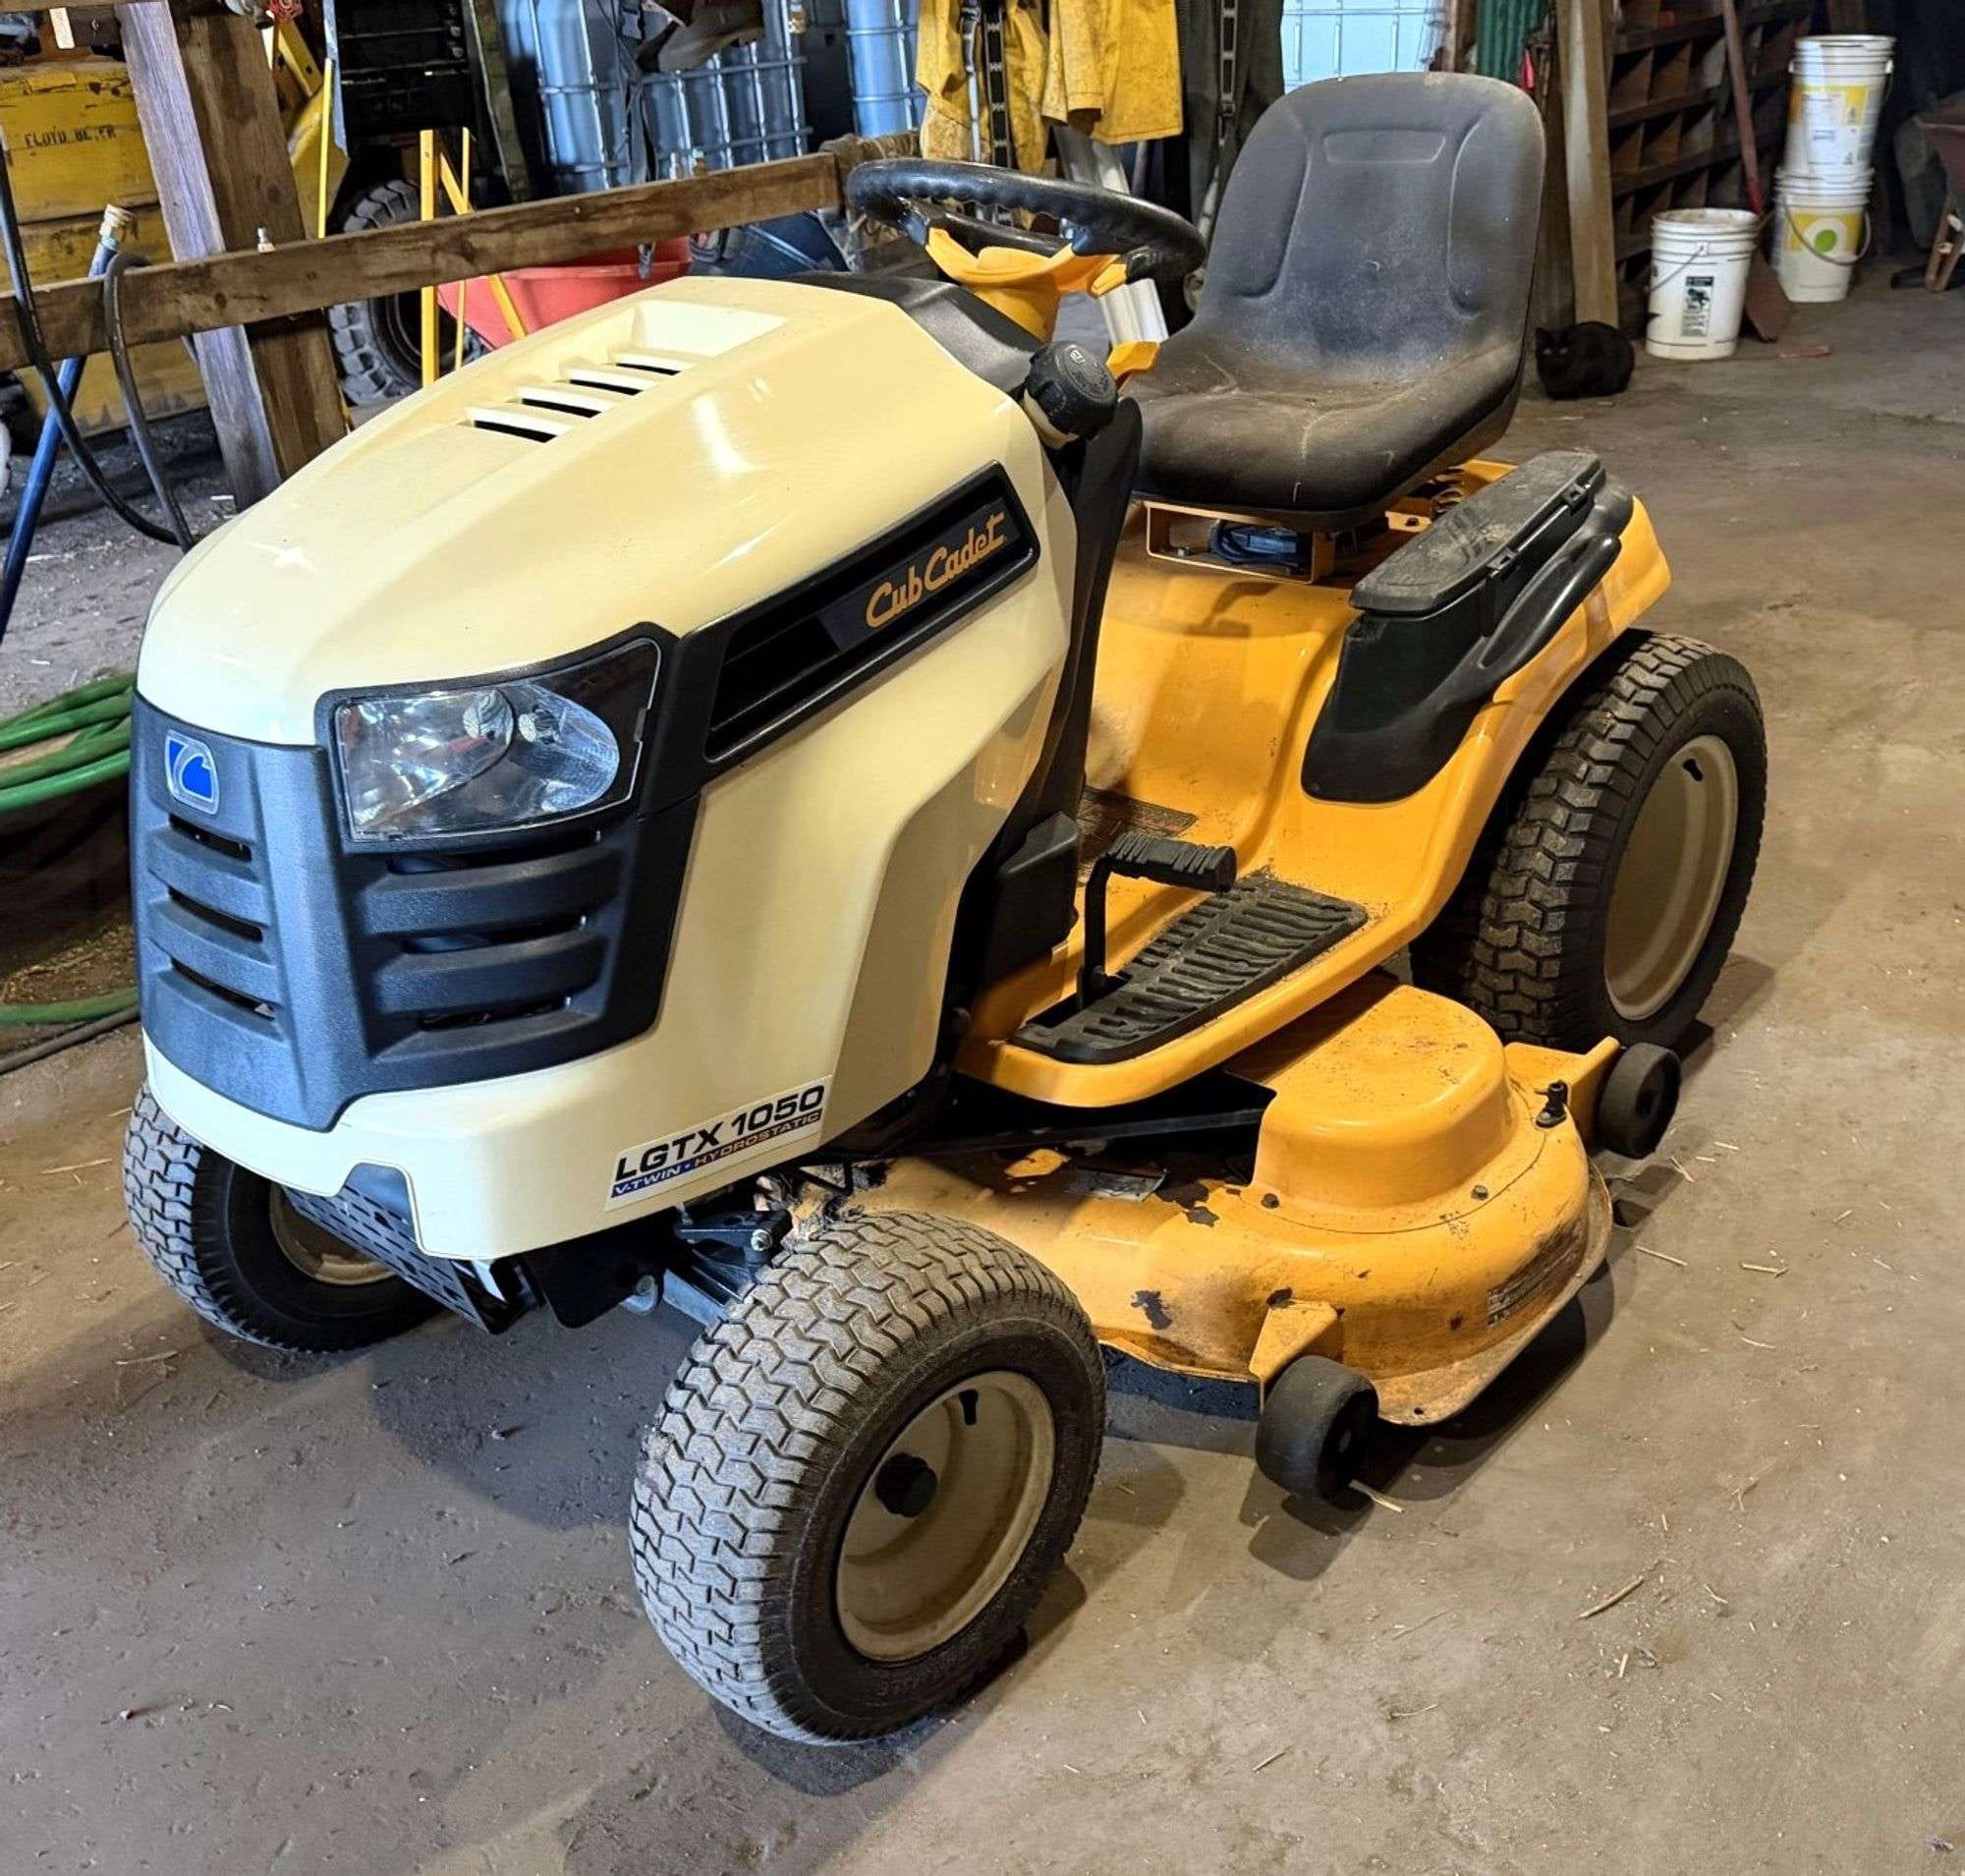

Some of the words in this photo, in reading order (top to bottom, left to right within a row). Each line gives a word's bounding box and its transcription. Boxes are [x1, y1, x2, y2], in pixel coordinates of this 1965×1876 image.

[866, 565, 923, 628] Cub
[924, 512, 1005, 591] Cadet
[614, 1165, 682, 1194] V-TWIN
[694, 1111, 821, 1167] HYDROSTATIC
[615, 1121, 724, 1182] LGTX
[731, 1085, 825, 1136] 1050
